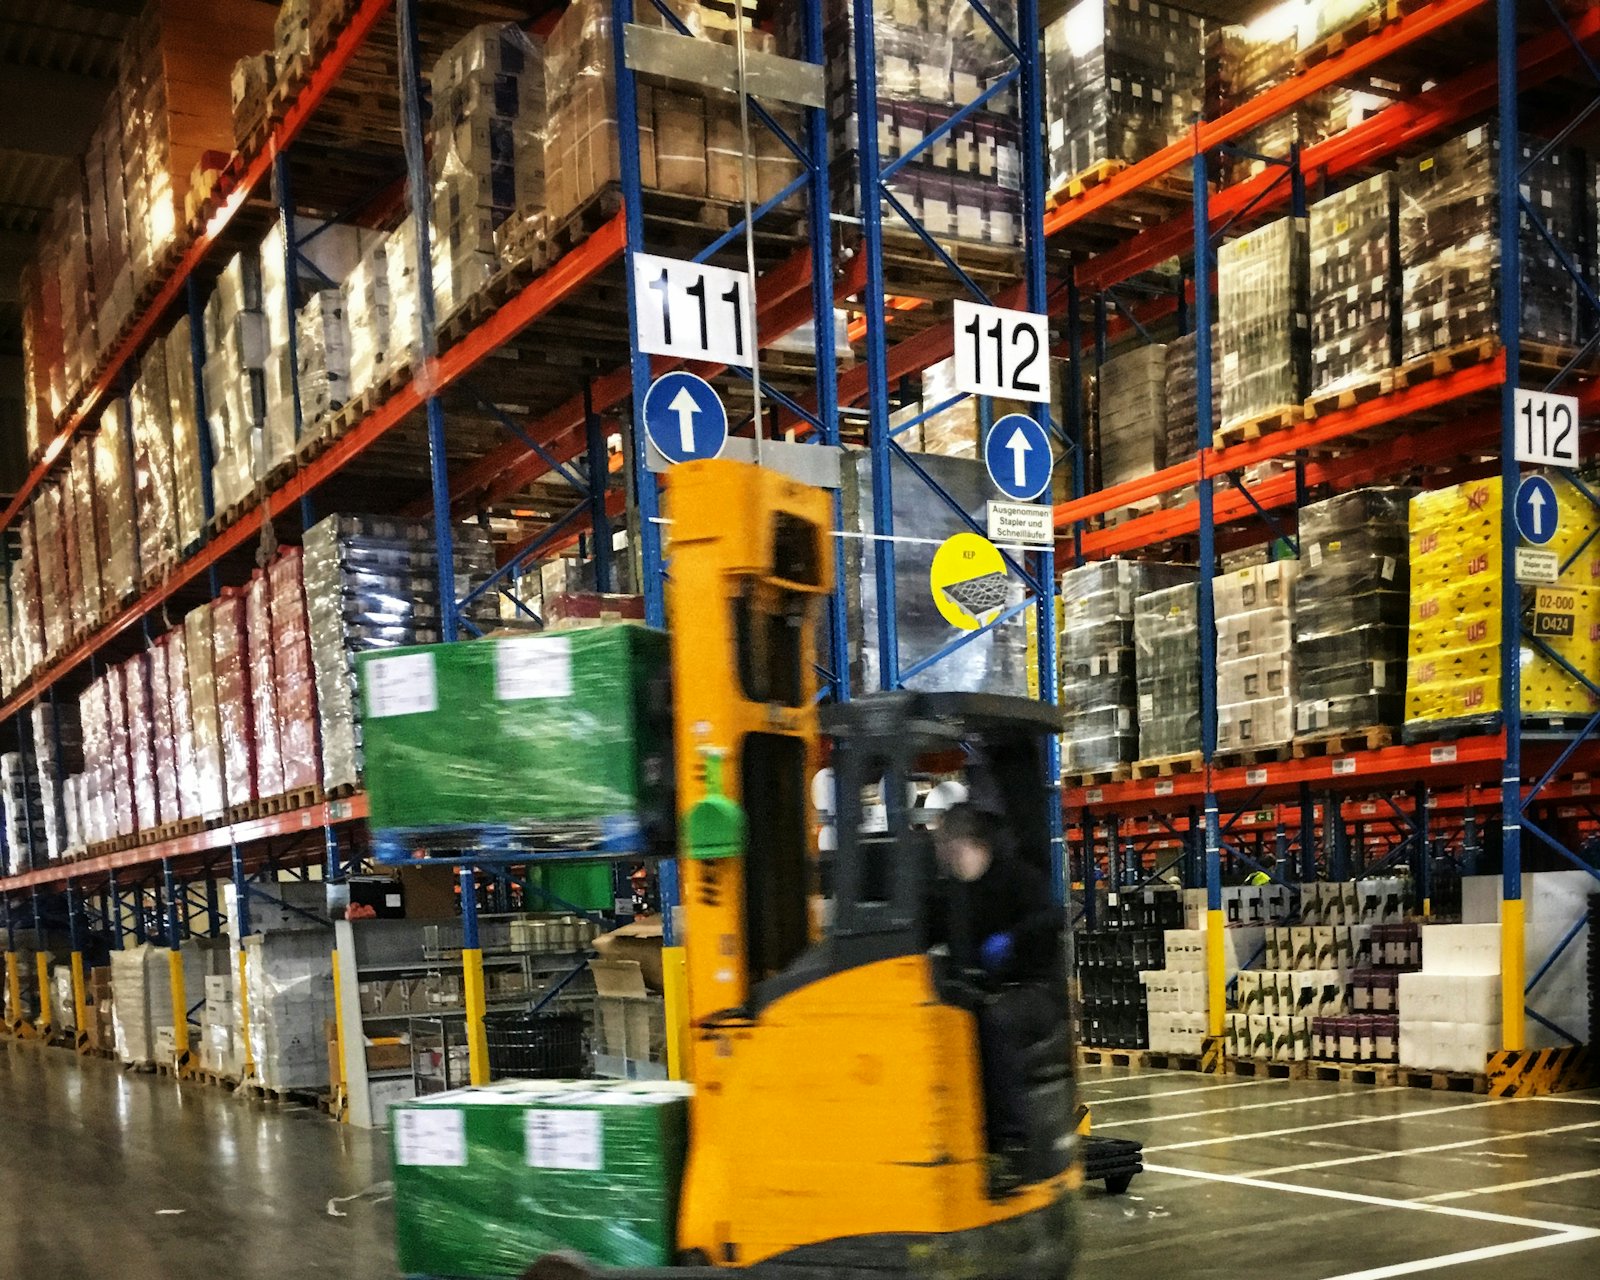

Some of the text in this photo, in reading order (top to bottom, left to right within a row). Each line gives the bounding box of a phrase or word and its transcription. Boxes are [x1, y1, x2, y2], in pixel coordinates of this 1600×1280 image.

[649, 268, 743, 355] 111
[965, 314, 1040, 392] 112
[1521, 398, 1572, 459] 112
[992, 505, 1049, 517] Ausgenommen
[999, 516, 1042, 528] Stapler und
[962, 550, 976, 560] KEP
[1540, 594, 1574, 610] 02-000
